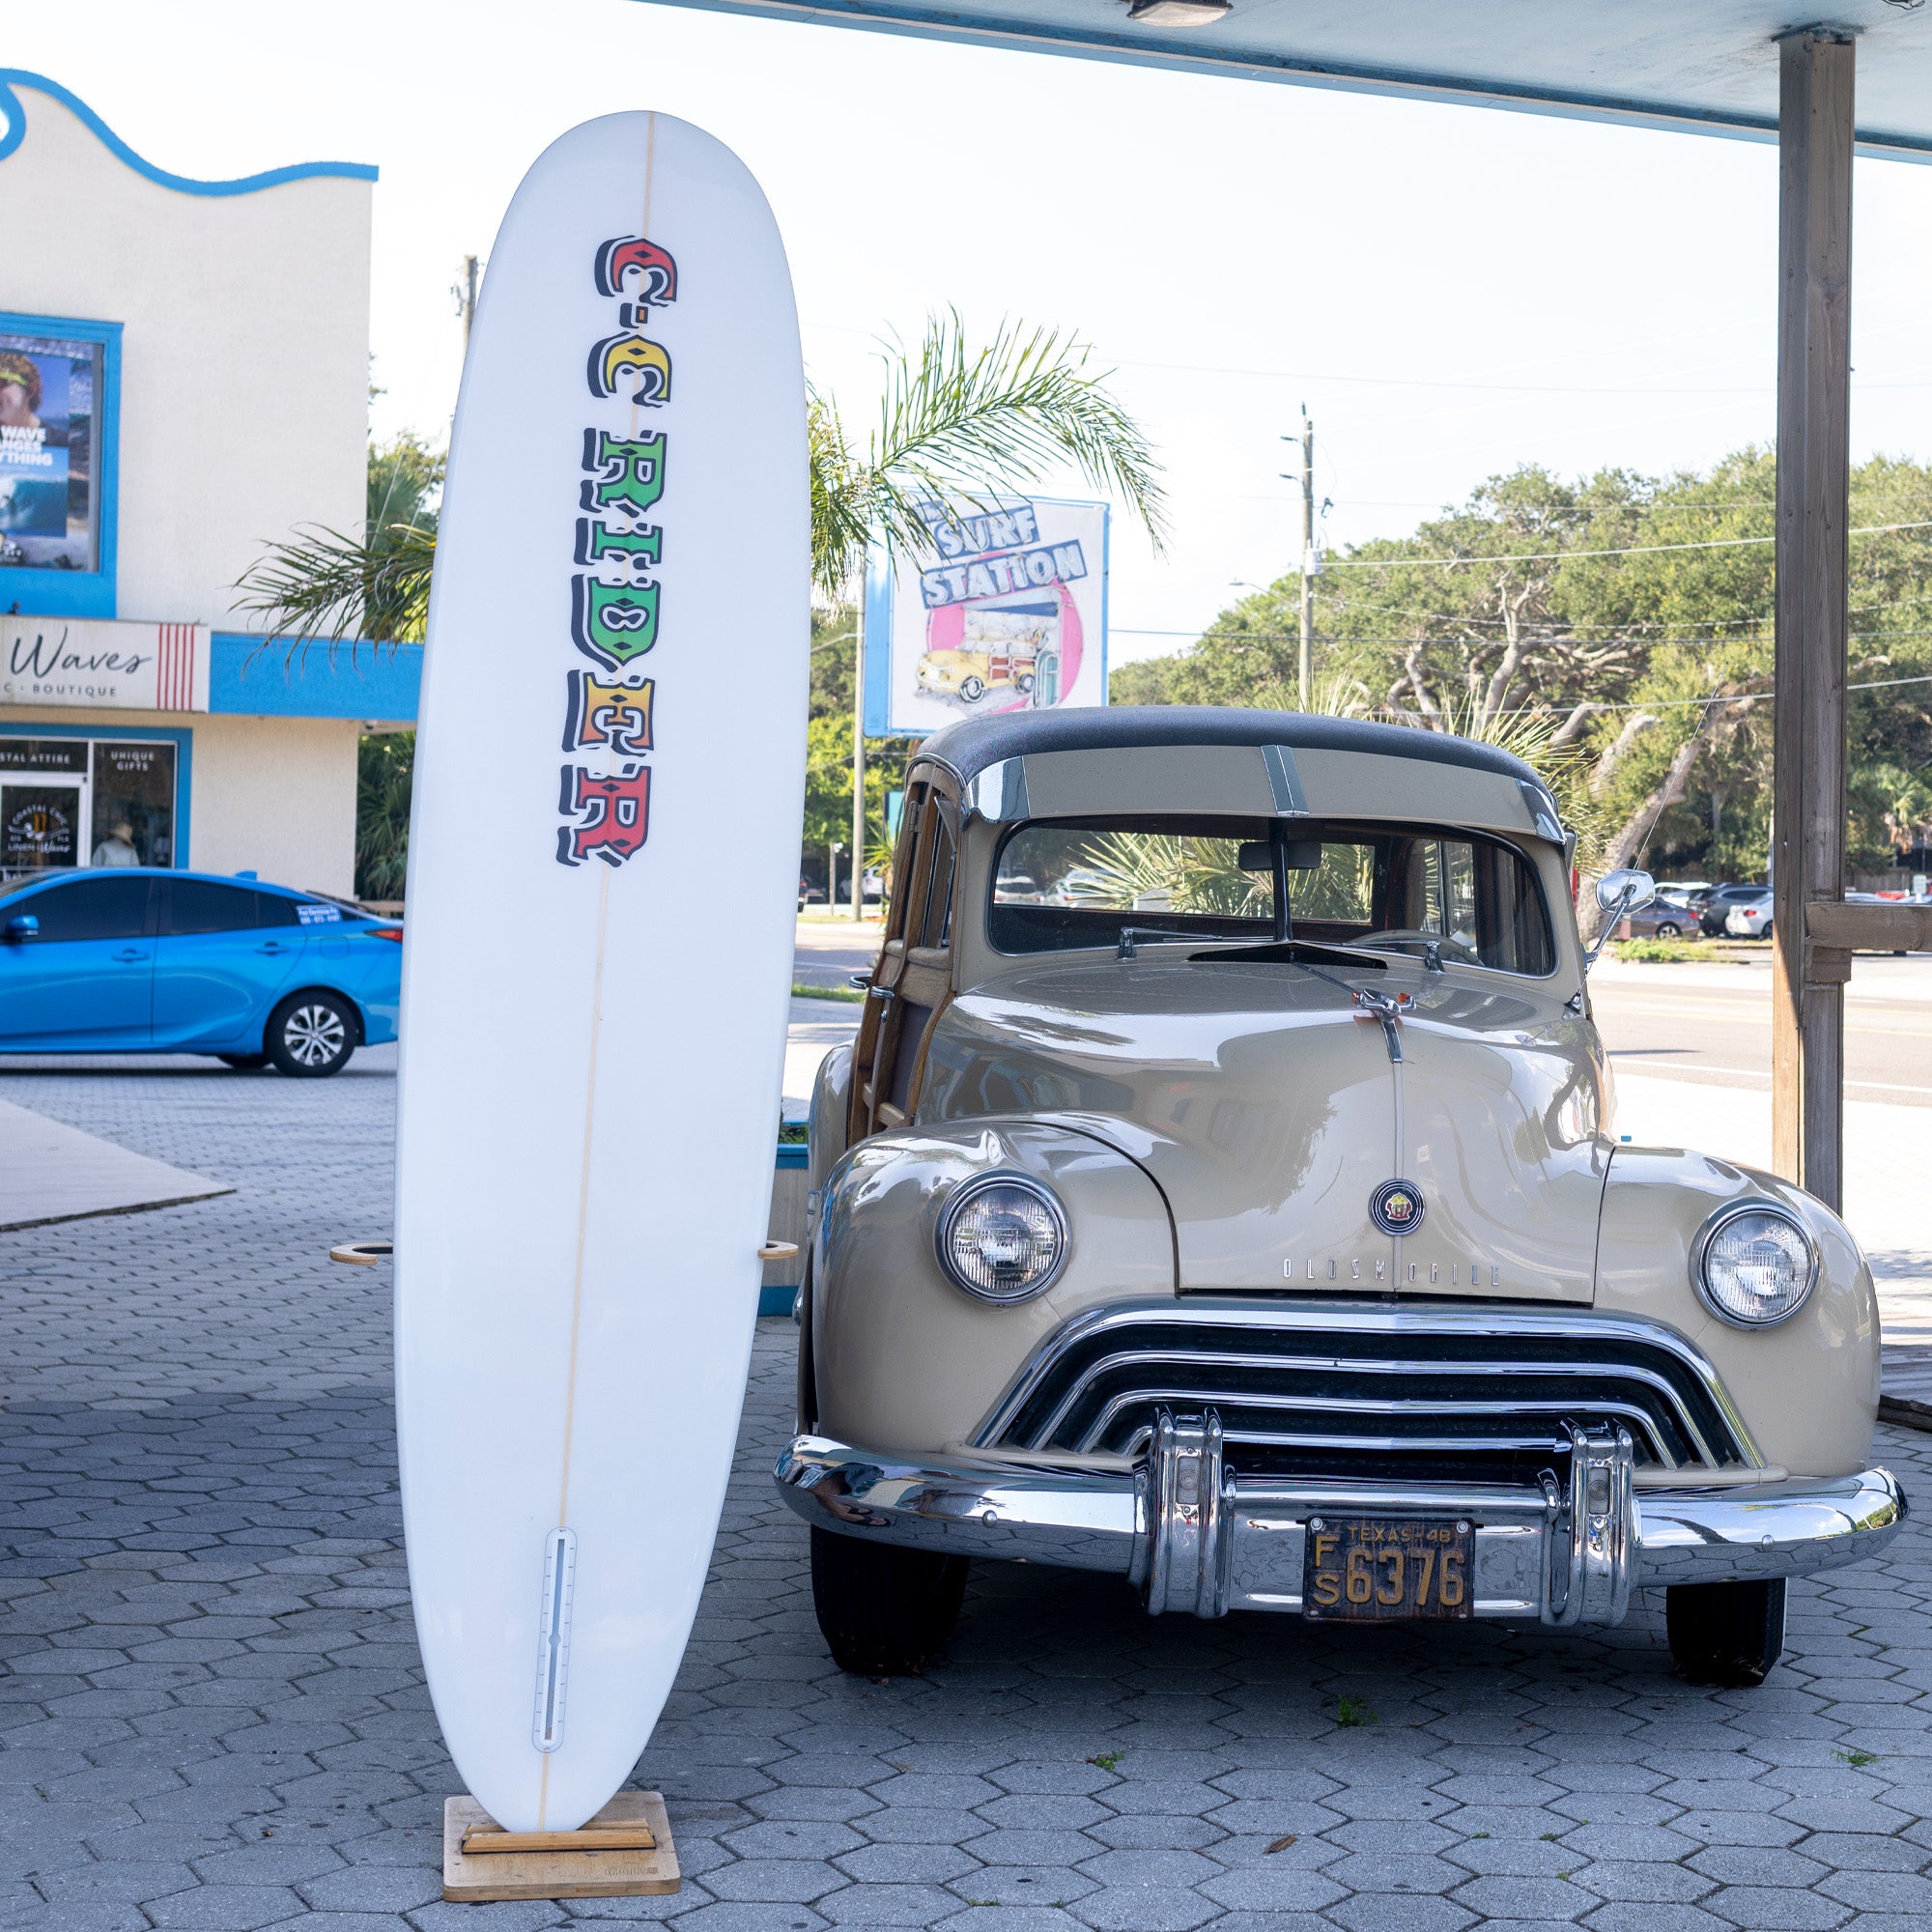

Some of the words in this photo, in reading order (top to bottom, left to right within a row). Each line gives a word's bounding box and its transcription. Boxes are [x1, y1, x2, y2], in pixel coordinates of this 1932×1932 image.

[0, 440, 43, 453] NGES
[936, 509, 1037, 557] SURF
[923, 543, 1087, 607] STATION
[10, 626, 153, 678] Waves
[556, 428, 668, 867] RIDER
[33, 684, 117, 698] BOUTIQUE
[30, 753, 71, 764] ATTIRE
[110, 751, 156, 763] UNIQUE
[116, 760, 150, 772] GIFTS
[1283, 1259, 1500, 1287] OLDSMOBILE
[1347, 1548, 1465, 1606] 6376
